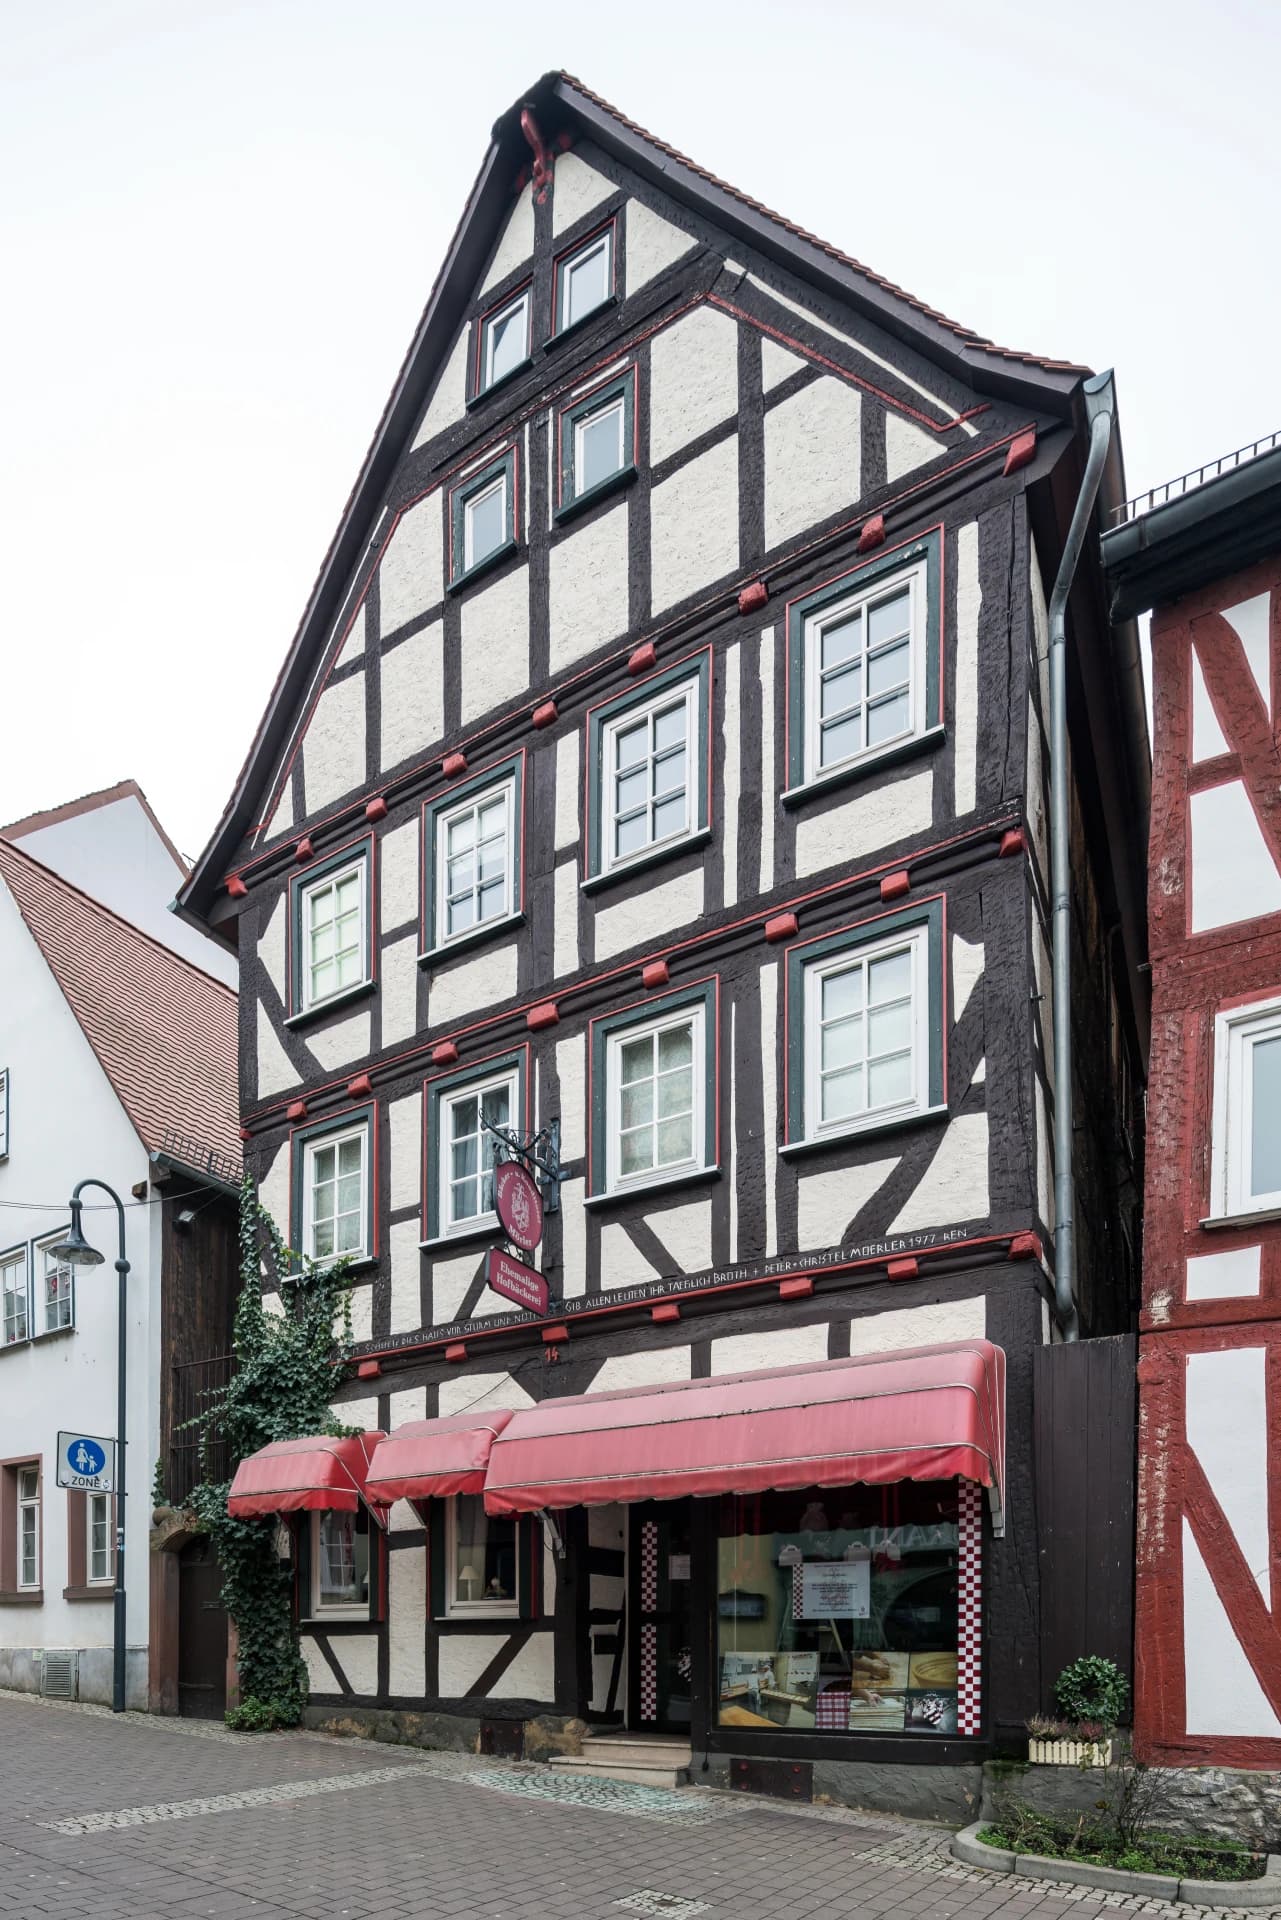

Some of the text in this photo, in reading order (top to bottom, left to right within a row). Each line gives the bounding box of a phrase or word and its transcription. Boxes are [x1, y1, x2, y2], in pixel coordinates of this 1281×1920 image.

[500, 1260, 540, 1292] Ehemalige
[565, 1301, 580, 1313] GIB
[585, 1296, 611, 1309] ALLEN
[650, 1285, 665, 1296] IHR
[713, 1267, 747, 1284] BROTH
[764, 1261, 791, 1273] PETER
[850, 1239, 906, 1258] MOERLER
[908, 1233, 936, 1247] 1977
[943, 1227, 967, 1241] REN
[496, 1272, 542, 1306] Hofbäckerei
[422, 1327, 445, 1342] HAUS
[464, 1320, 491, 1333] STURM
[71, 1475, 100, 1488] ZONE
